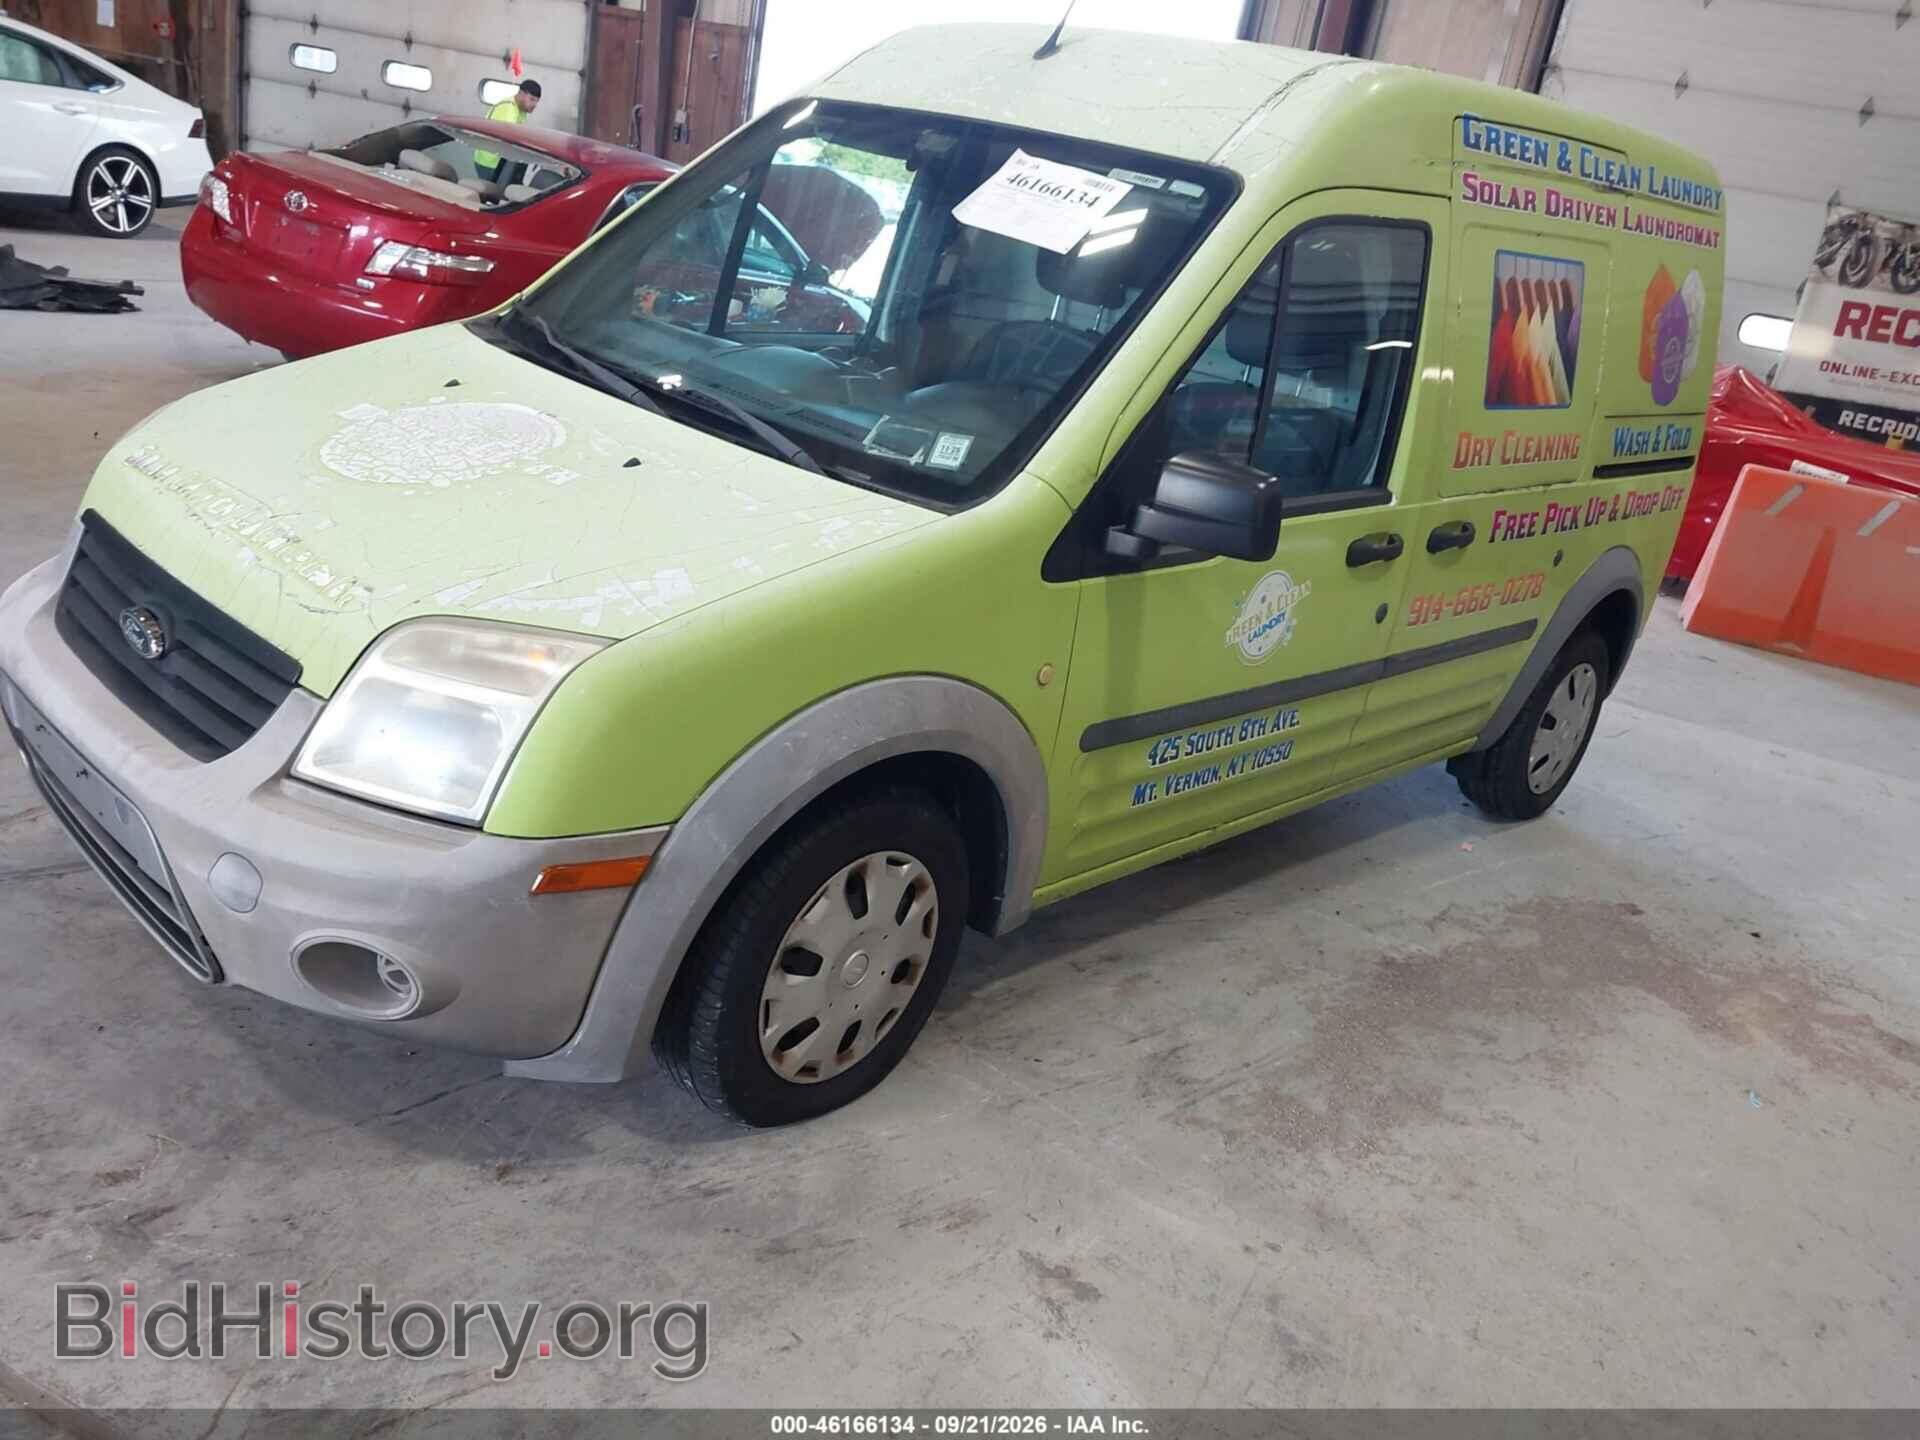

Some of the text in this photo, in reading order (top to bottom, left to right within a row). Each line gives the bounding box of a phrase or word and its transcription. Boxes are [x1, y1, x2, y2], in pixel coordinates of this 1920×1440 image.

[1556, 140, 1571, 174] &
[1007, 171, 1101, 208] 46166134
[1652, 426, 1662, 452] &
[1608, 494, 1619, 522] &
[1148, 734, 1183, 767] 425
[1249, 738, 1296, 771] 10550
